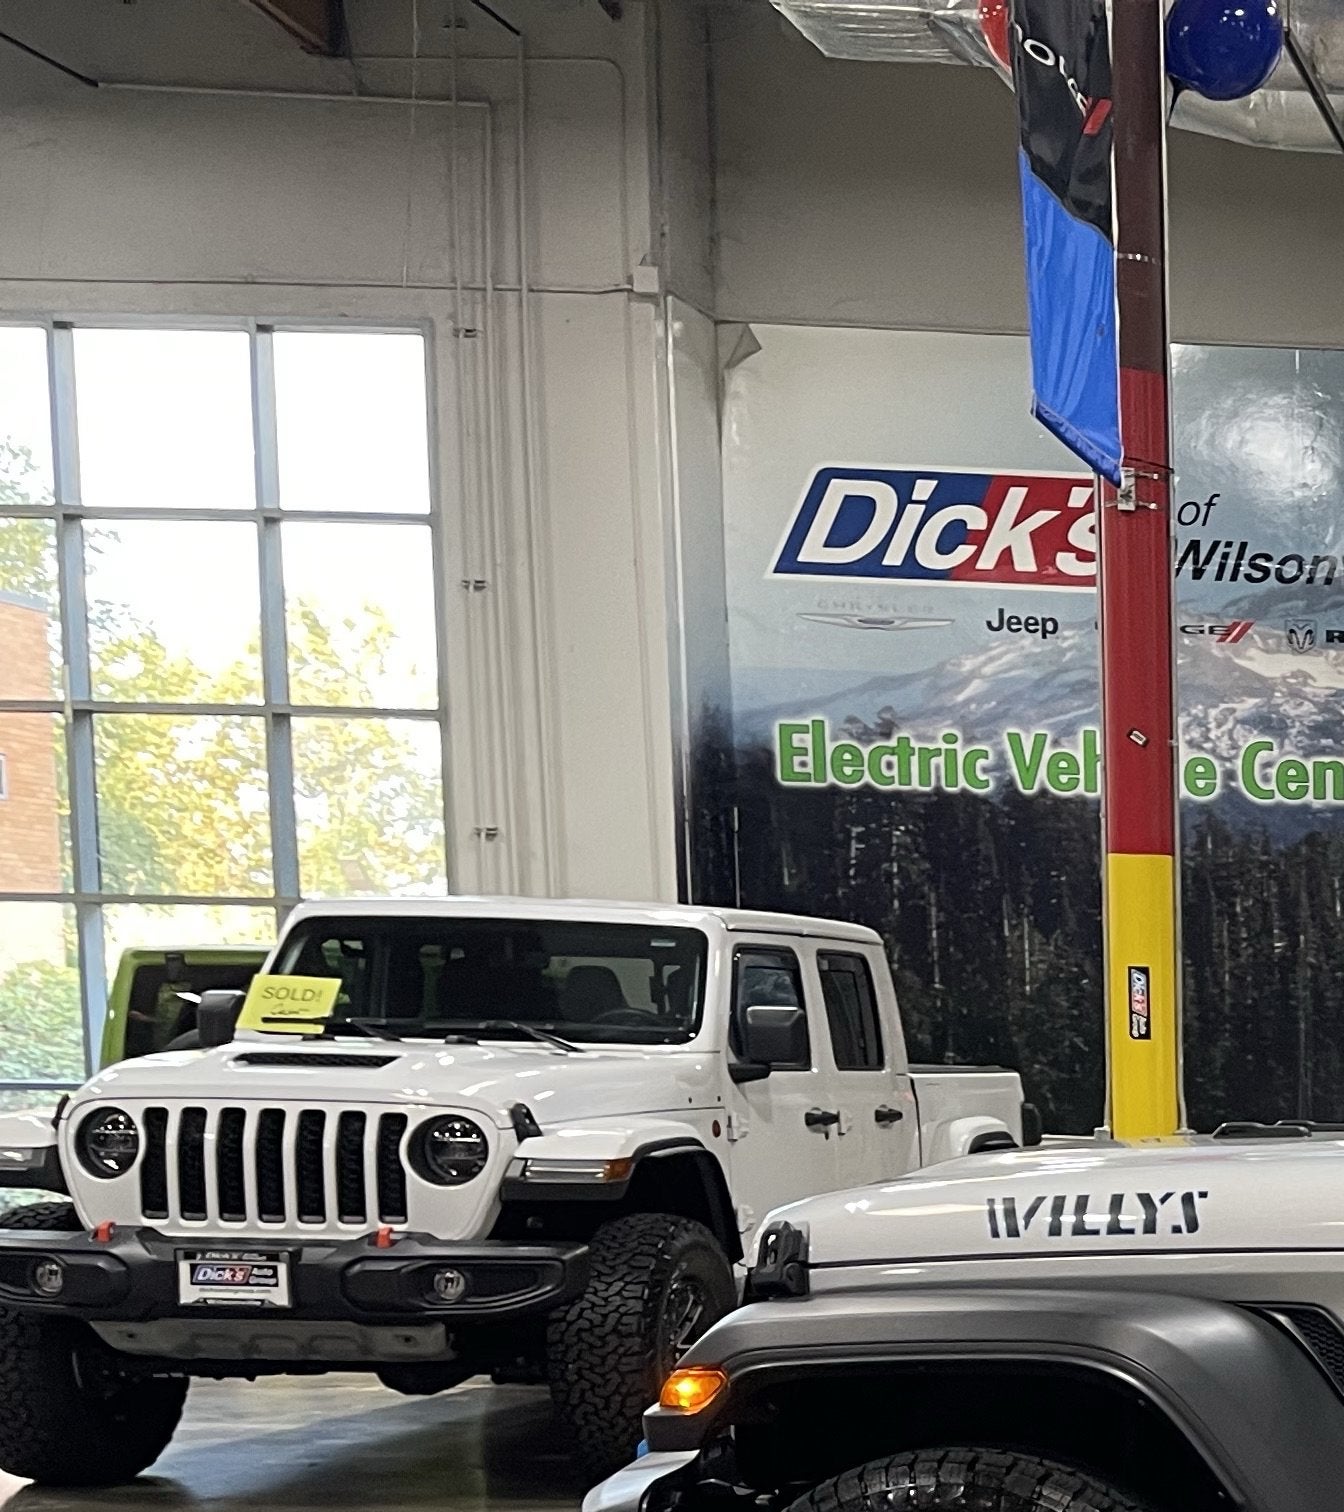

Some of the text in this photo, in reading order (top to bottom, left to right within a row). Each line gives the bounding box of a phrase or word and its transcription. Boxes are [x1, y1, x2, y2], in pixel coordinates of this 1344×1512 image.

[797, 478, 1098, 577] Dick's
[1177, 493, 1221, 527] of
[985, 607, 1059, 640] Jeep
[778, 719, 990, 790] Electric
[986, 1190, 1208, 1239] WILLYS
